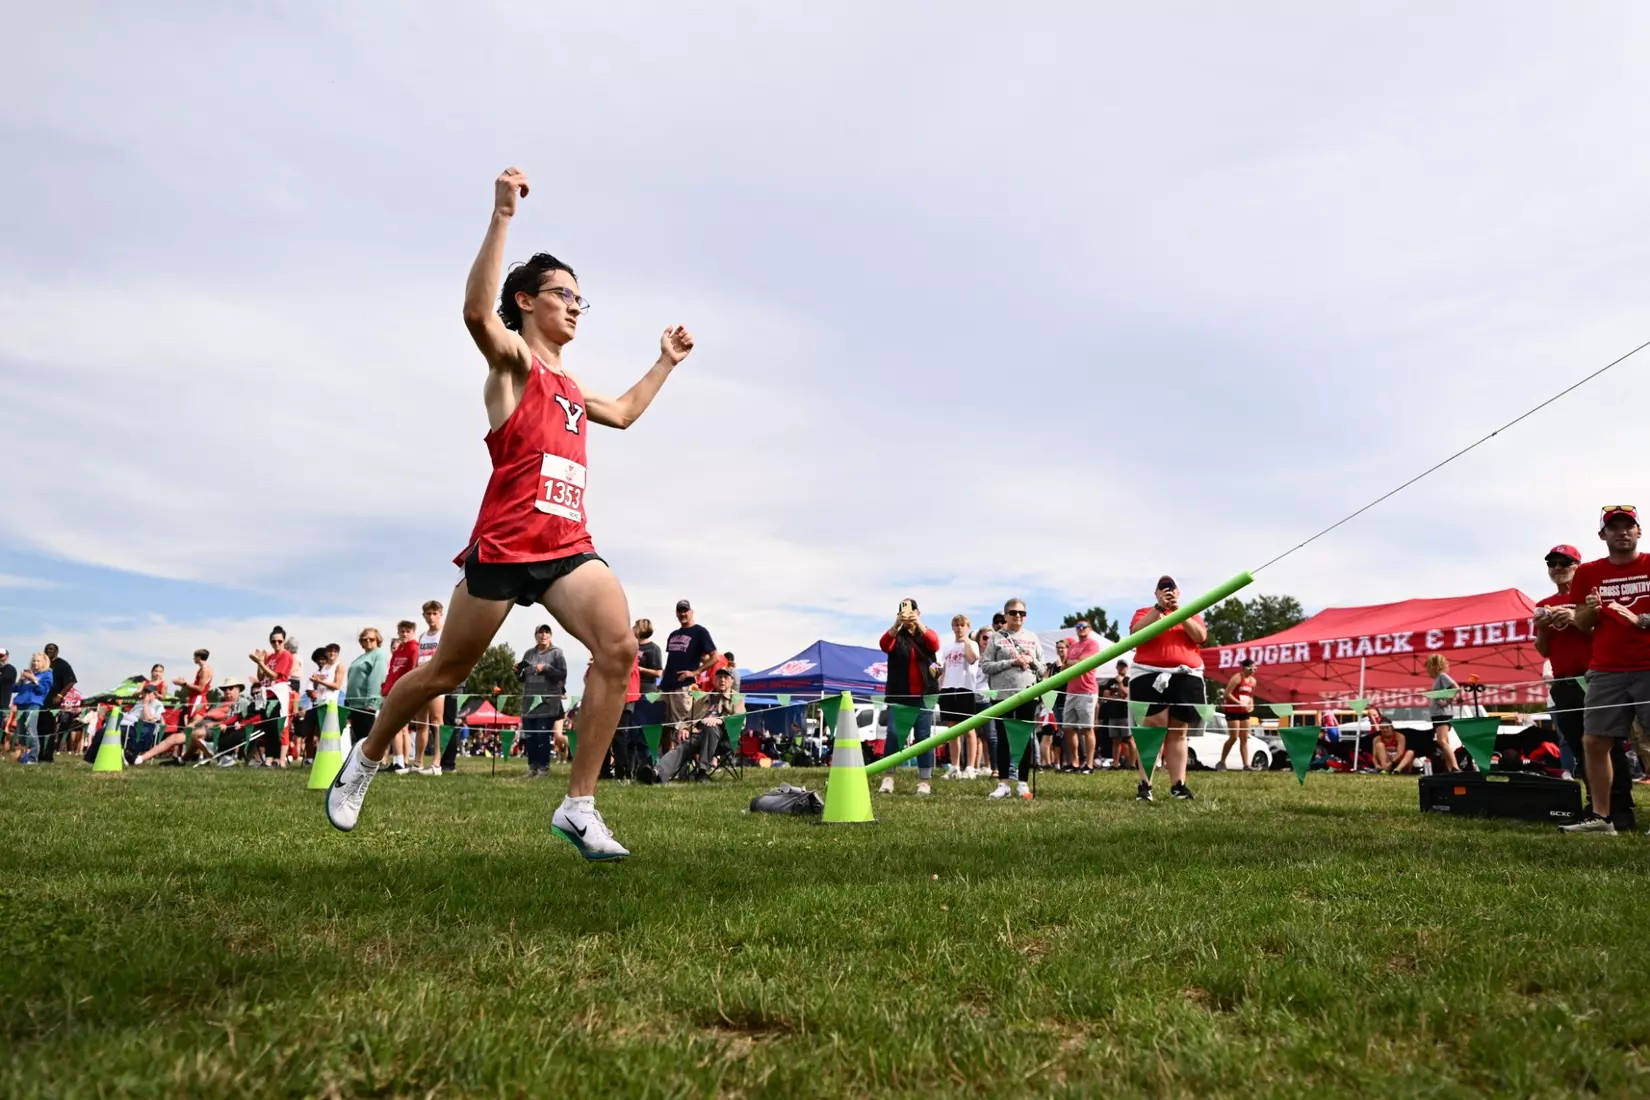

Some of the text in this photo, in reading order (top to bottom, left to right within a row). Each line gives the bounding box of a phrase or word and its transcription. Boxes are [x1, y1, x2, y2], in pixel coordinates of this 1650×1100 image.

[554, 393, 583, 435] Y
[544, 479, 581, 509] 1353
[1599, 581, 1650, 596] CROSS COUNTRY
[1218, 641, 1311, 669] BADGER
[1318, 630, 1414, 661] TRACK
